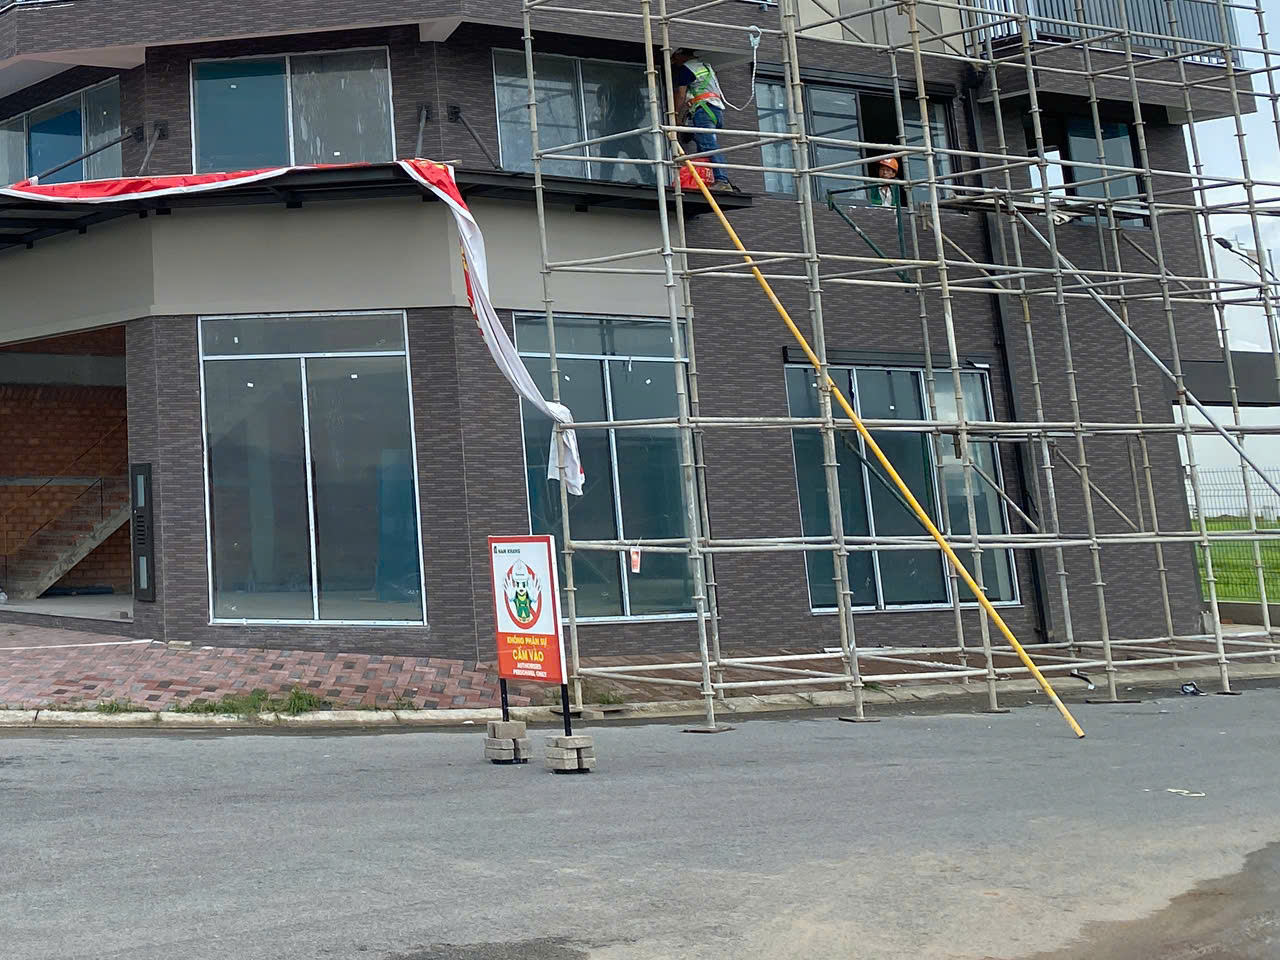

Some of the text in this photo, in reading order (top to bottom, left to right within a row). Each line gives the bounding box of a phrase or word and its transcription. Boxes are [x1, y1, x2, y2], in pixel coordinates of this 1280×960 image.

[507, 635, 524, 645] KHÔNG
[512, 645, 544, 662] CẤM VÀO
